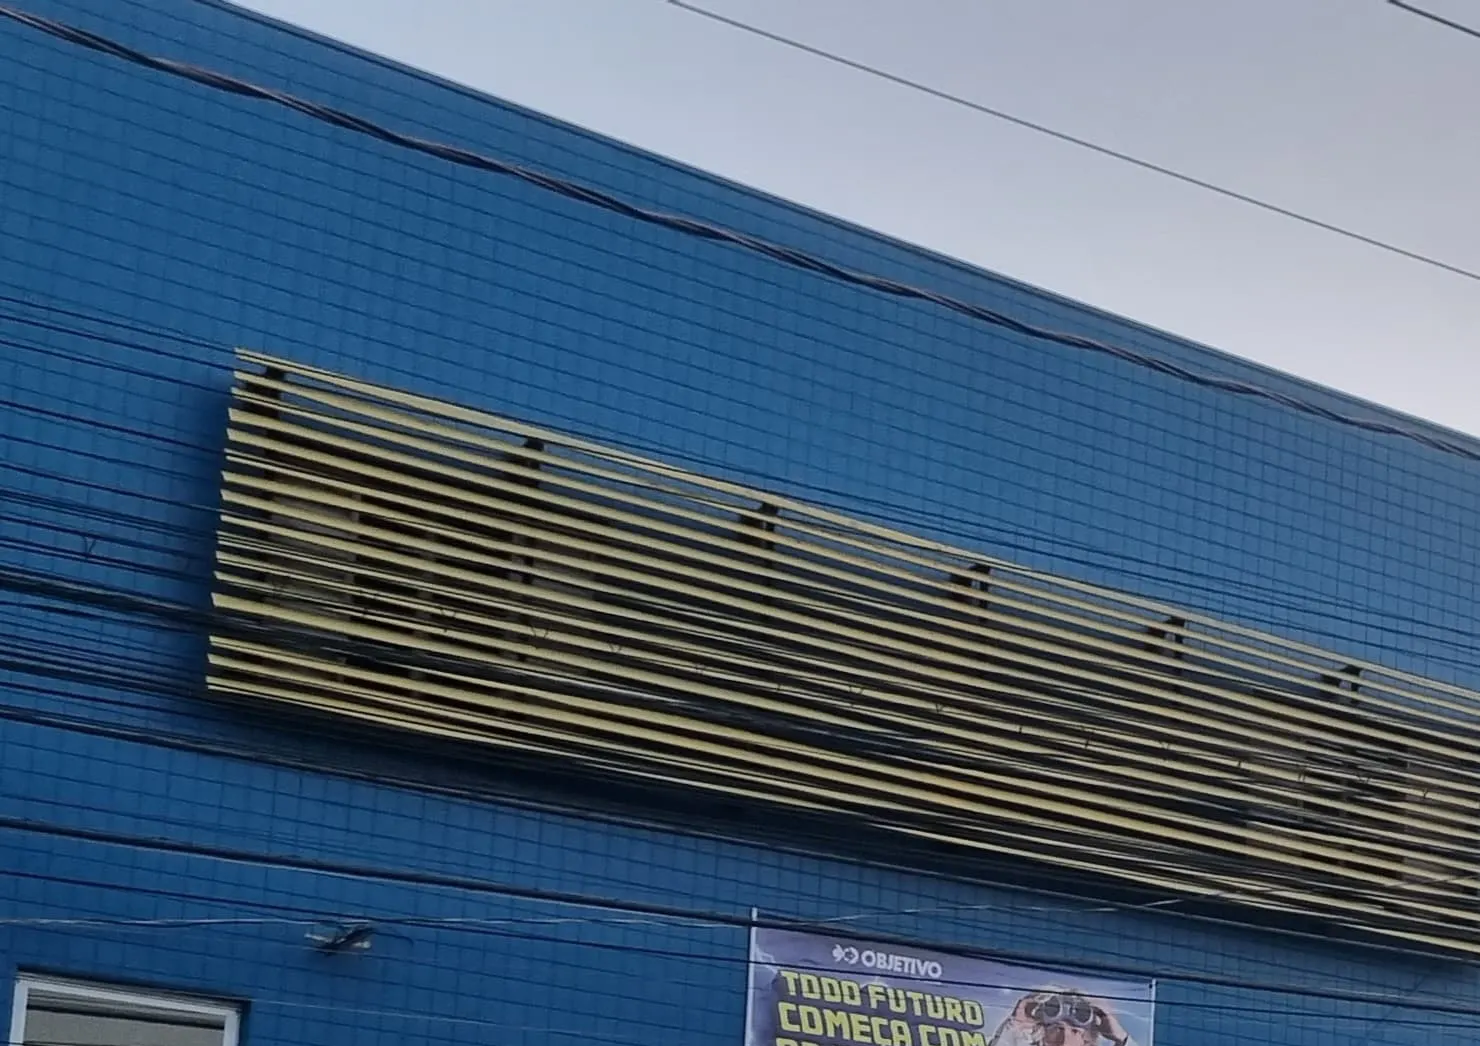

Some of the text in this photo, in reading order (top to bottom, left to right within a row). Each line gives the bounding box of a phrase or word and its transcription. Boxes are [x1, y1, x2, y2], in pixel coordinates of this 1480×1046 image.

[861, 950, 943, 978] OBJETIVO
[780, 971, 984, 1026] TODO FUTURO
